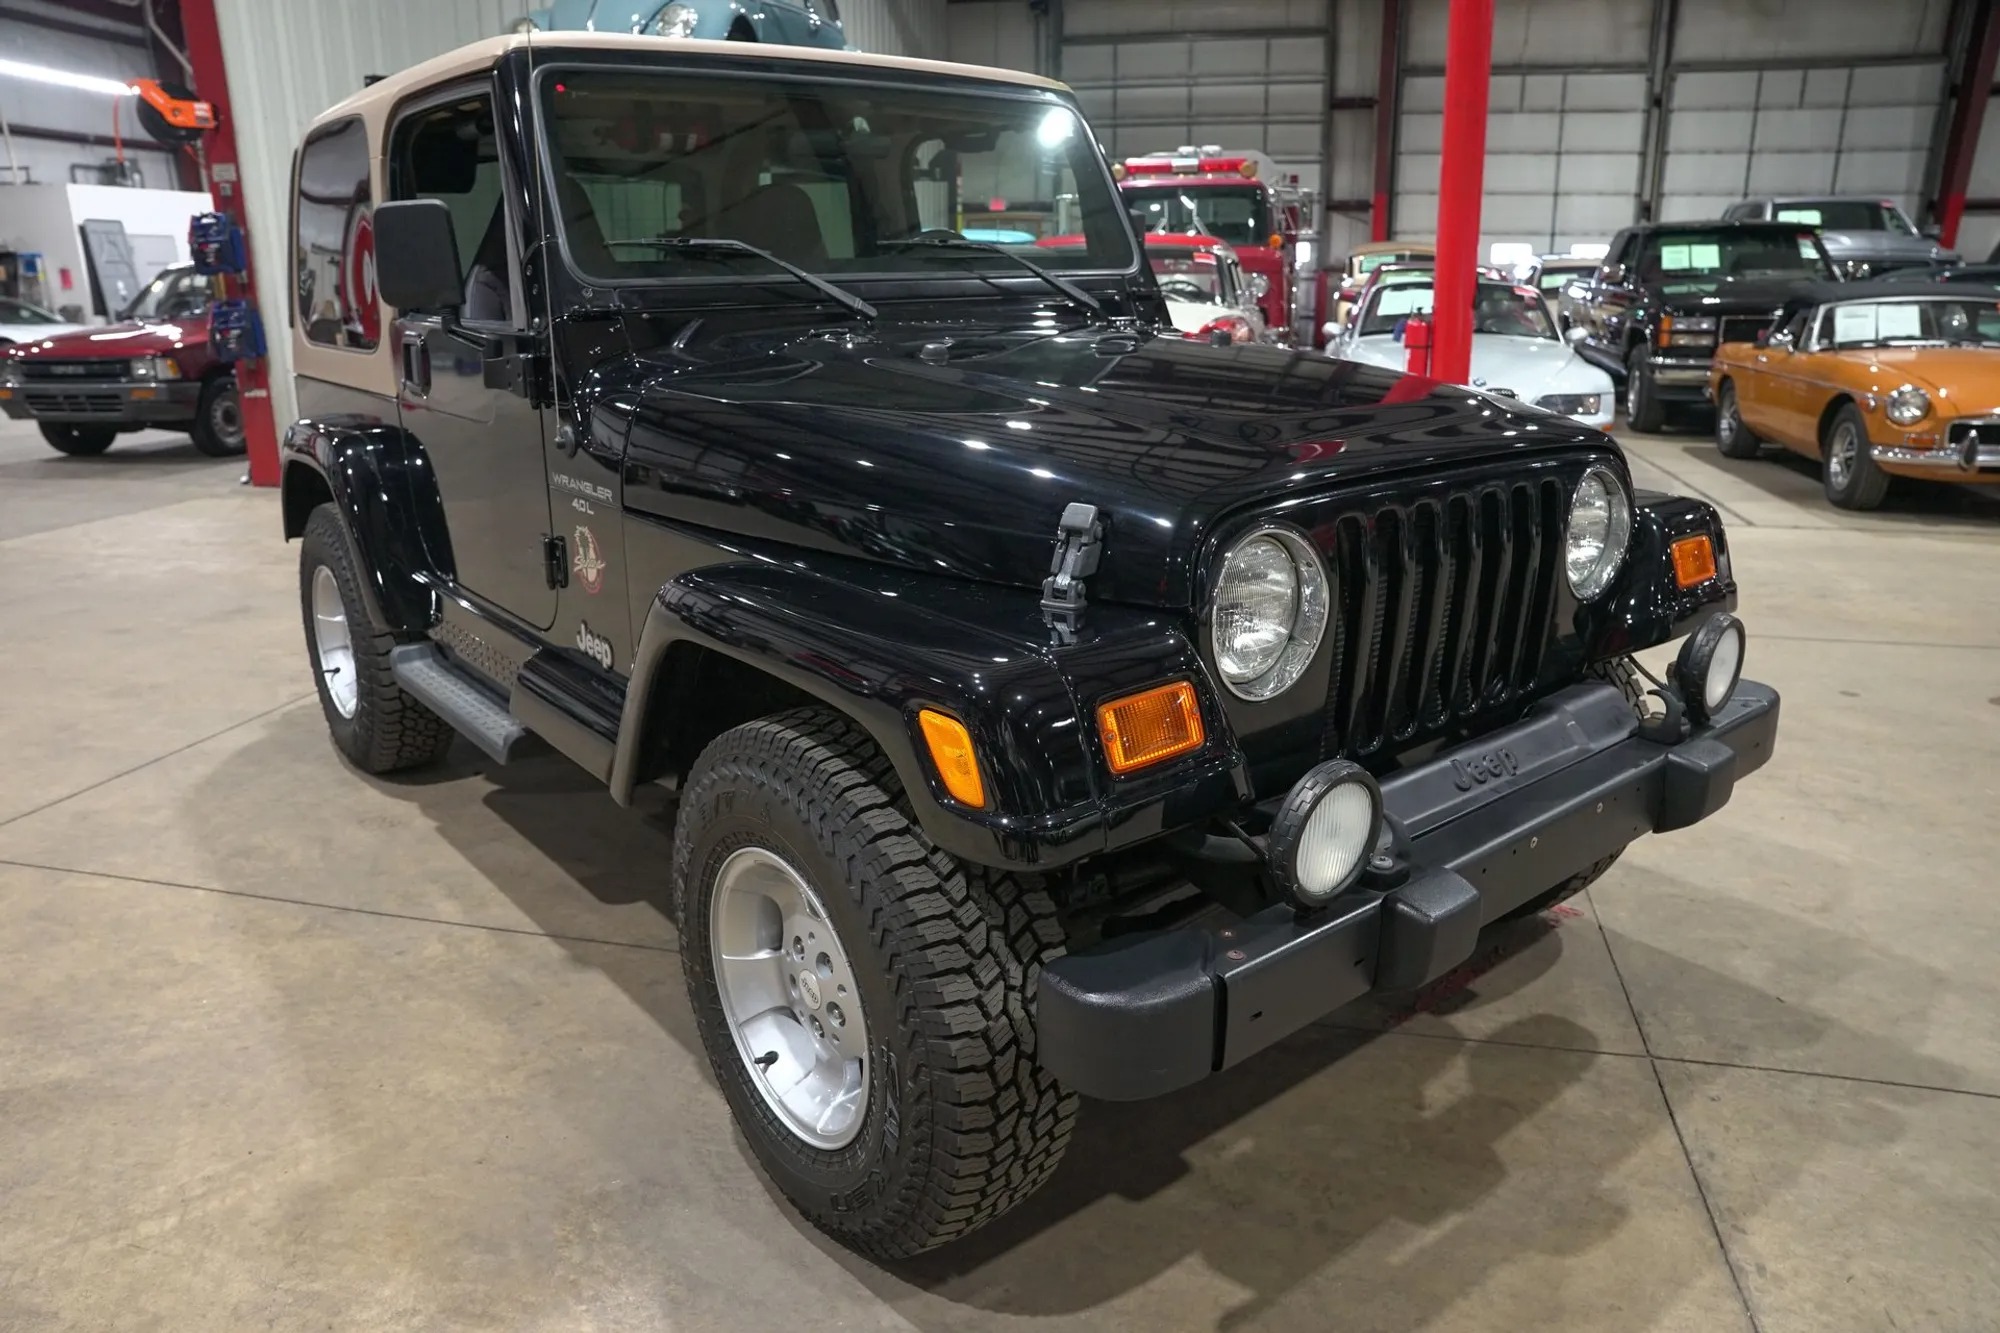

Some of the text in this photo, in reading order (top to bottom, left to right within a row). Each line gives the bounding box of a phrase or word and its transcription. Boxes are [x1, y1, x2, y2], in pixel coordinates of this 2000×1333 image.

[552, 472, 613, 503] WRANGLER
[576, 621, 614, 670] Jeep
[1450, 748, 1518, 792] Jeep
